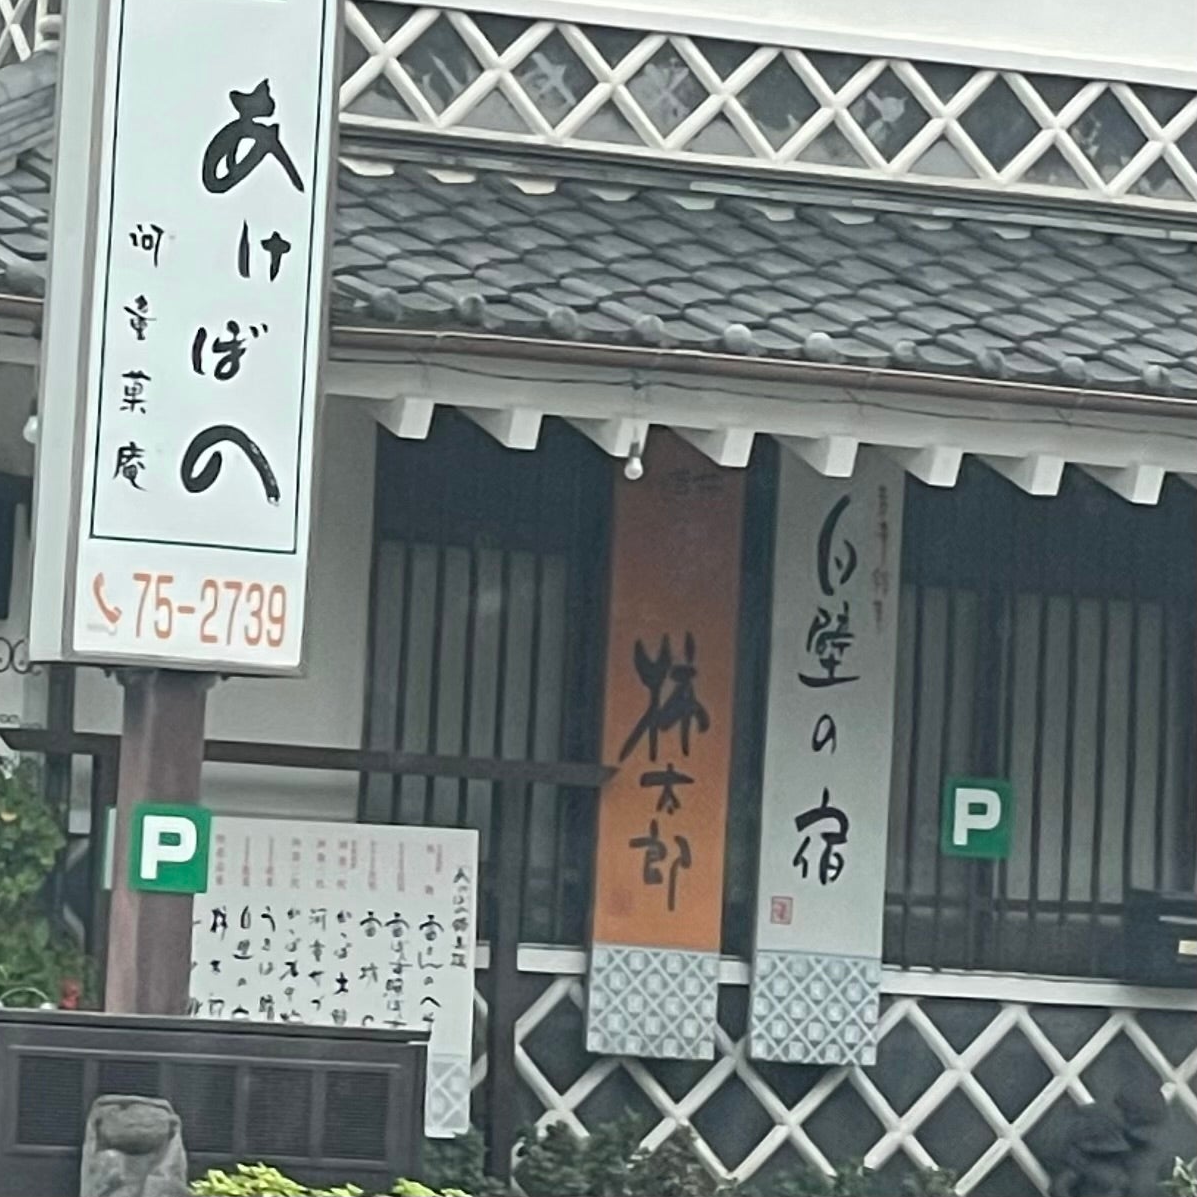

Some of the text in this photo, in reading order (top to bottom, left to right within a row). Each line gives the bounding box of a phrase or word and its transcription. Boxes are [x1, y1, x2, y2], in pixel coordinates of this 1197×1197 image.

[180, 78, 305, 507] あけぼの
[111, 222, 165, 492] 河童菓庵
[132, 572, 287, 649] 75-2739
[139, 814, 198, 880] P
[952, 787, 1002, 846] P
